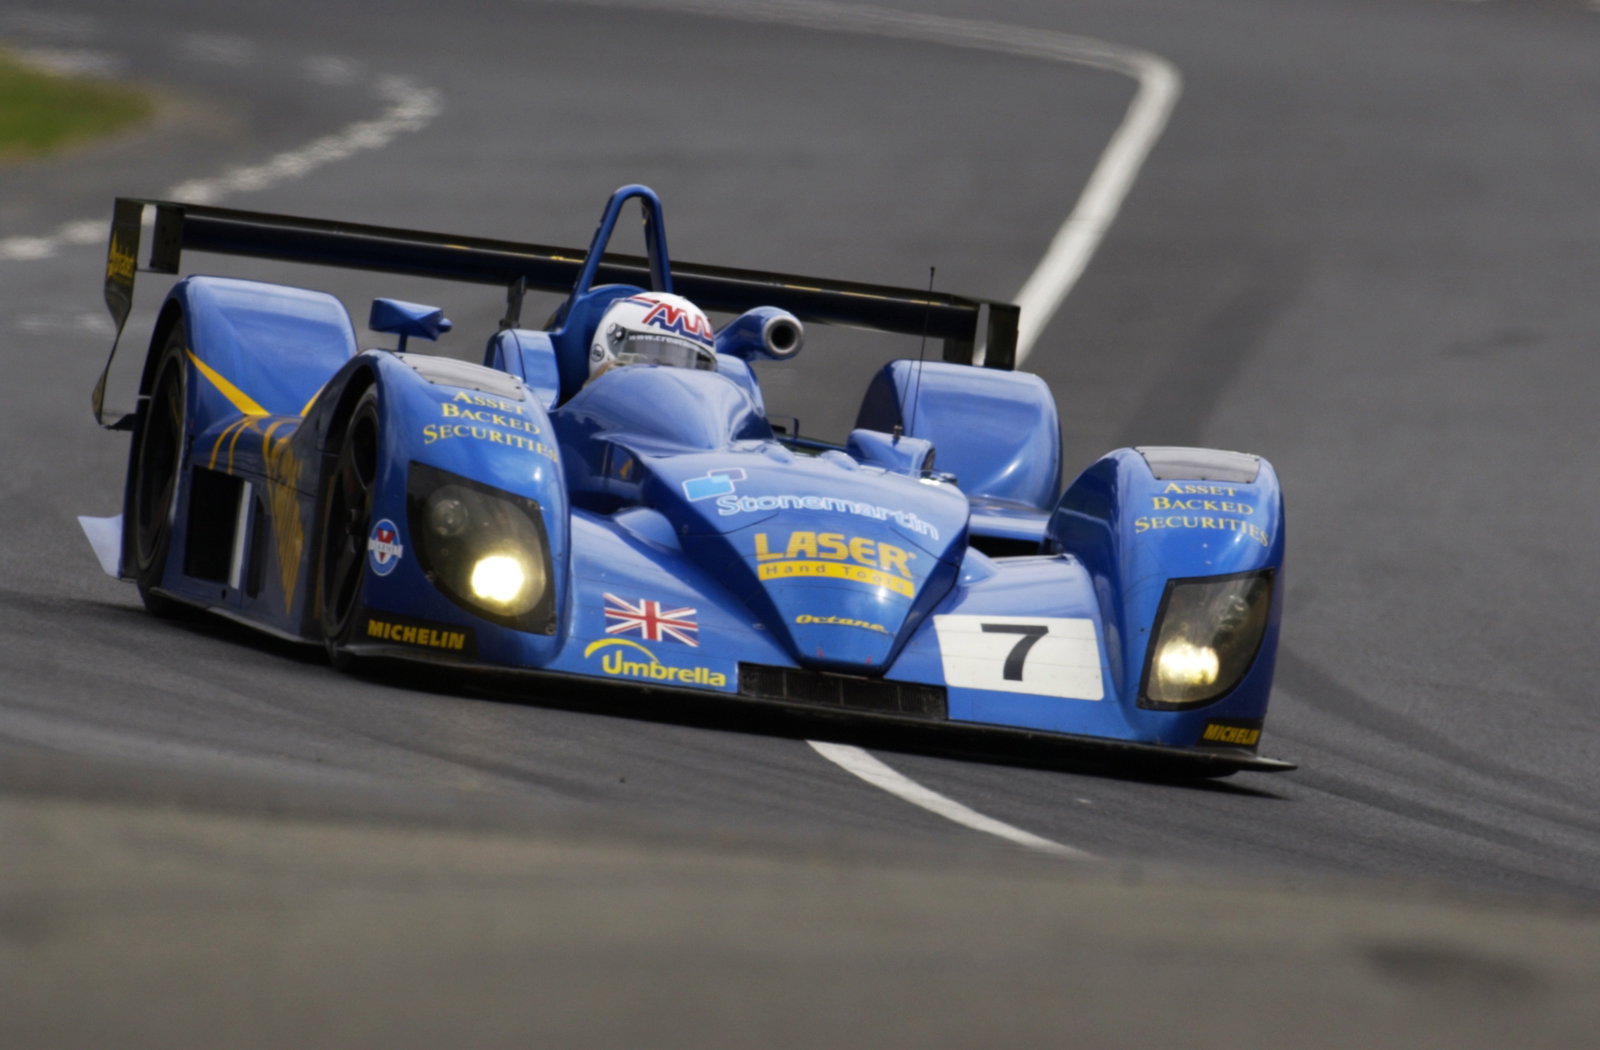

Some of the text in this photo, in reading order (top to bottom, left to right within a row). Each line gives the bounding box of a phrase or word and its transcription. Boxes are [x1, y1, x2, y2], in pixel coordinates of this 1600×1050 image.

[441, 402, 542, 435] BACKED
[453, 391, 525, 415] ASSET
[1163, 482, 1237, 497] ASSET
[715, 494, 940, 541] Stonemartin
[1151, 496, 1254, 516] BACKED
[1133, 515, 1269, 547] SECURITIES
[754, 531, 913, 579] LASER
[765, 563, 827, 576] Hand
[367, 618, 466, 650] MICHELIN
[601, 650, 727, 687] Umbrella
[980, 623, 1049, 682] 7
